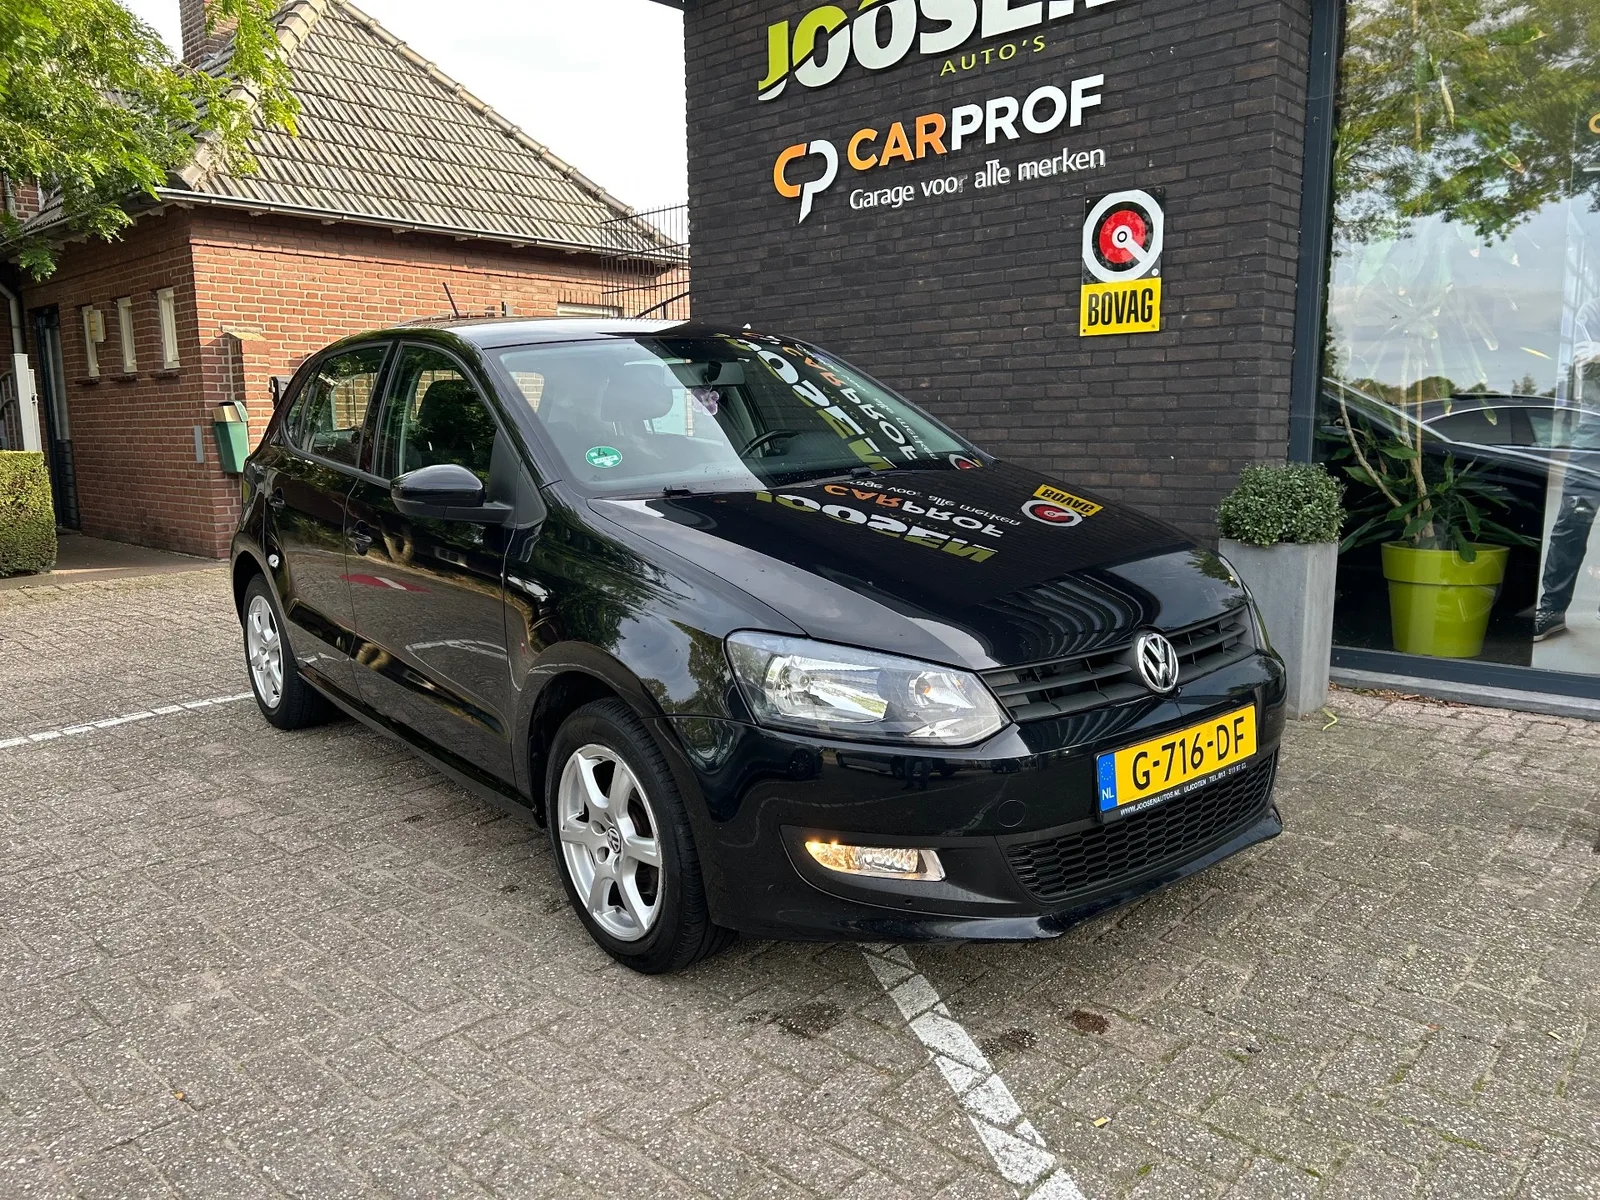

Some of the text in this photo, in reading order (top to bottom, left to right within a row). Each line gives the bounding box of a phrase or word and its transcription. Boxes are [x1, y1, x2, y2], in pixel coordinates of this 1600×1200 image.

[758, 0, 1116, 100] JOOS
[940, 35, 1046, 76] AUTO'S
[847, 74, 1104, 171] CARPROF
[850, 147, 1106, 210] Garage voor alle merken
[1087, 288, 1154, 325] BOVAG
[1132, 716, 1244, 790] G-716-DF
[1102, 787, 1115, 801] NL
